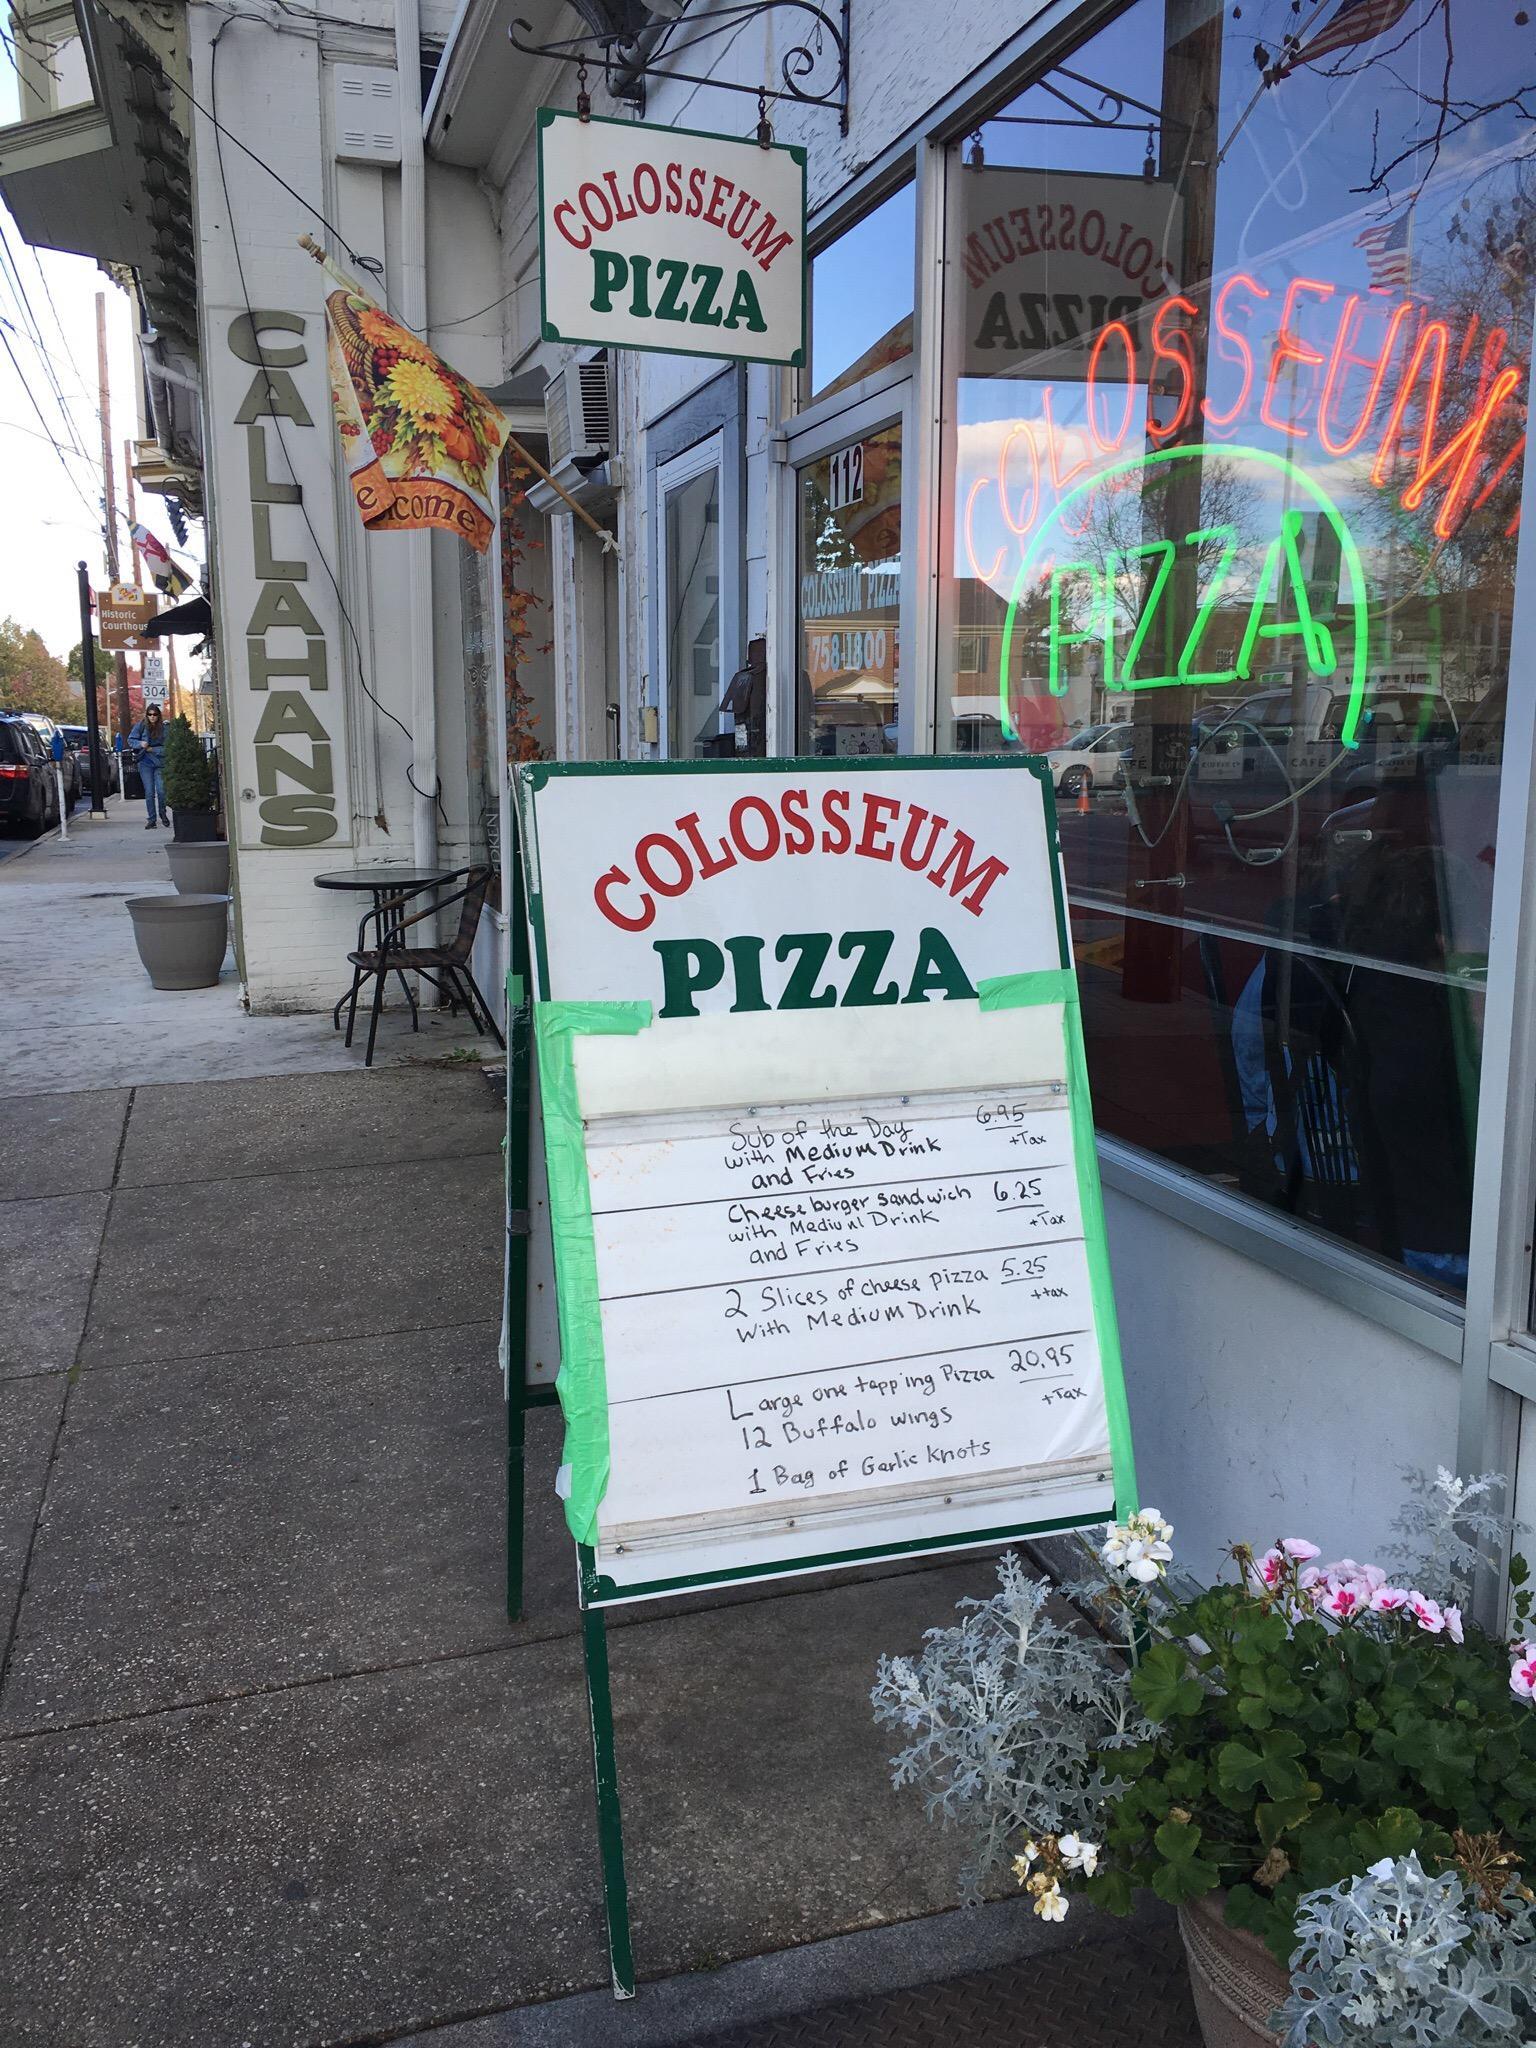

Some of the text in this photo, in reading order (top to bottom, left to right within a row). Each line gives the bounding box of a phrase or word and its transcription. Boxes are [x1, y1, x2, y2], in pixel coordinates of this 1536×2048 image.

[553, 163, 794, 272] COLOSSEUM
[590, 249, 768, 333] PIZZA
[965, 273, 1521, 582] COLOSSEUM
[832, 446, 862, 507] 112
[227, 310, 338, 847] CALLAHANS
[800, 565, 863, 619] COLOSSEUM
[101, 609, 137, 619] Historic
[1051, 510, 1336, 697] PIZZA
[102, 621, 149, 631] Courthous
[148, 659, 161, 667] TO
[812, 629, 886, 673] 758-1800
[144, 686, 166, 697] 304
[593, 789, 1010, 932] COLOSSEUM
[652, 927, 980, 1019] PIZZA
[976, 1103, 1028, 1126] 6.95
[729, 1116, 914, 1152] Sub of the Day
[724, 1146, 775, 1170] with
[880, 1136, 942, 1157] Drink
[751, 1163, 856, 1191] and Fries
[993, 1177, 1043, 1202] 6.25
[728, 1225, 777, 1244] with
[867, 1208, 940, 1228] Drink
[749, 1241, 788, 1265] and
[1000, 1255, 1048, 1278] 5.25
[724, 1288, 749, 1319] 2
[761, 1285, 828, 1313] Slices
[837, 1277, 855, 1301] of
[860, 1274, 921, 1297] cheese
[907, 1293, 983, 1320] Drink
[1008, 1343, 1075, 1373] 20.95
[727, 1388, 804, 1421] Large
[812, 1385, 848, 1403] one
[742, 1405, 954, 1450] 12 Buffalo wings
[748, 1467, 768, 1495] 1
[773, 1463, 816, 1489] Bag
[828, 1459, 849, 1480] of
[861, 1448, 919, 1477] Garlic
